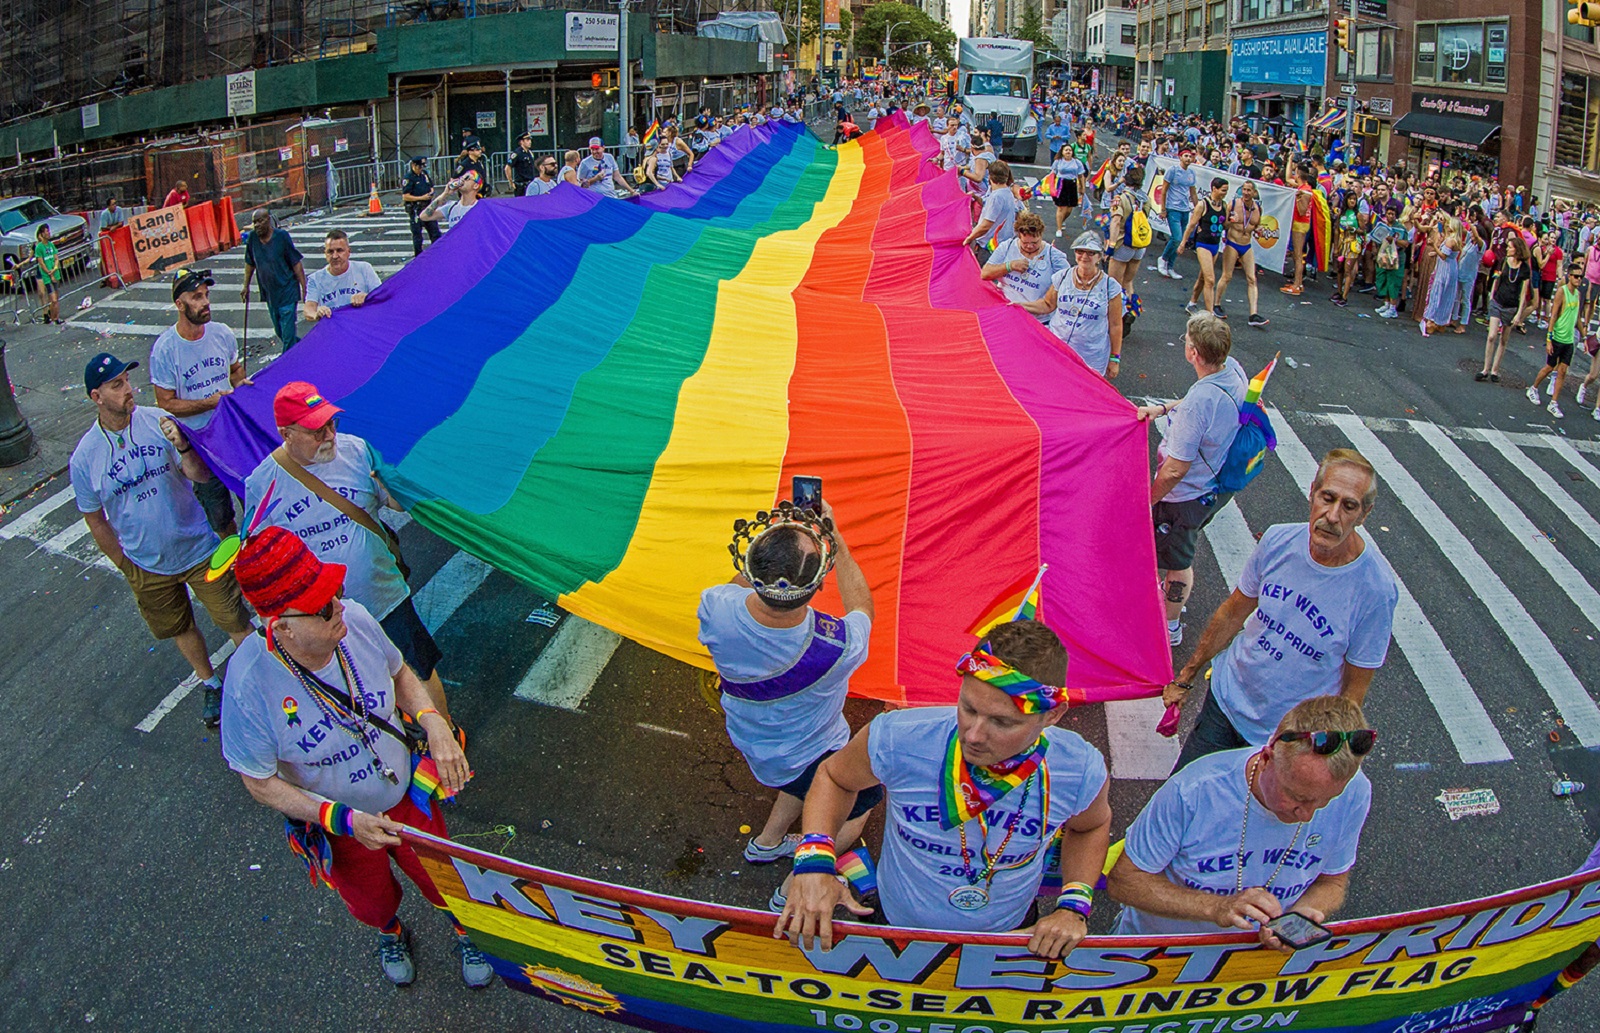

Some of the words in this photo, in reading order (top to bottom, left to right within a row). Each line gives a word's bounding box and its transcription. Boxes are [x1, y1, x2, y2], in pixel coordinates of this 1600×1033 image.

[585, 17, 595, 25] 250
[607, 18, 616, 26] AVE
[1233, 41, 1261, 57] FLAGSHIP
[1262, 39, 1282, 55] RETAIL
[1283, 37, 1325, 54] AVAILABLE
[135, 212, 174, 231] Lane
[135, 225, 188, 253] Closed
[1020, 278, 1040, 290] PRIDE
[321, 290, 338, 304] KEY
[1076, 295, 1101, 311] WEST
[1077, 312, 1099, 321] PRIDE
[182, 363, 199, 381] KEY
[200, 356, 226, 369] WEST
[185, 379, 211, 394] WORLD
[107, 455, 128, 480] KEY
[128, 445, 164, 461] WEST
[112, 474, 144, 497] WORLD
[143, 462, 171, 481] PRIDE
[136, 487, 159, 503] 2019
[284, 495, 312, 523] KEY
[320, 534, 349, 552] 2019
[1261, 582, 1294, 602] KEY
[1294, 593, 1335, 639] WEST
[1256, 608, 1286, 636] ORLD
[1283, 630, 1325, 662] PRIDE
[1257, 635, 1284, 661] 2019
[296, 713, 335, 754] KEY
[902, 805, 941, 823] KE
[1197, 850, 1254, 874] KEY
[1262, 848, 1323, 871] WEST
[450, 854, 732, 959] KEY
[784, 932, 1267, 993] WEST
[1277, 880, 1600, 976] PRIDE
[598, 942, 997, 1018] SEA-TO-SEA
[1021, 974, 1330, 1022] RAINBOW
[1336, 955, 1479, 998] FLAG
[1392, 1014, 1450, 1033] Key
[1449, 997, 1510, 1025] West
